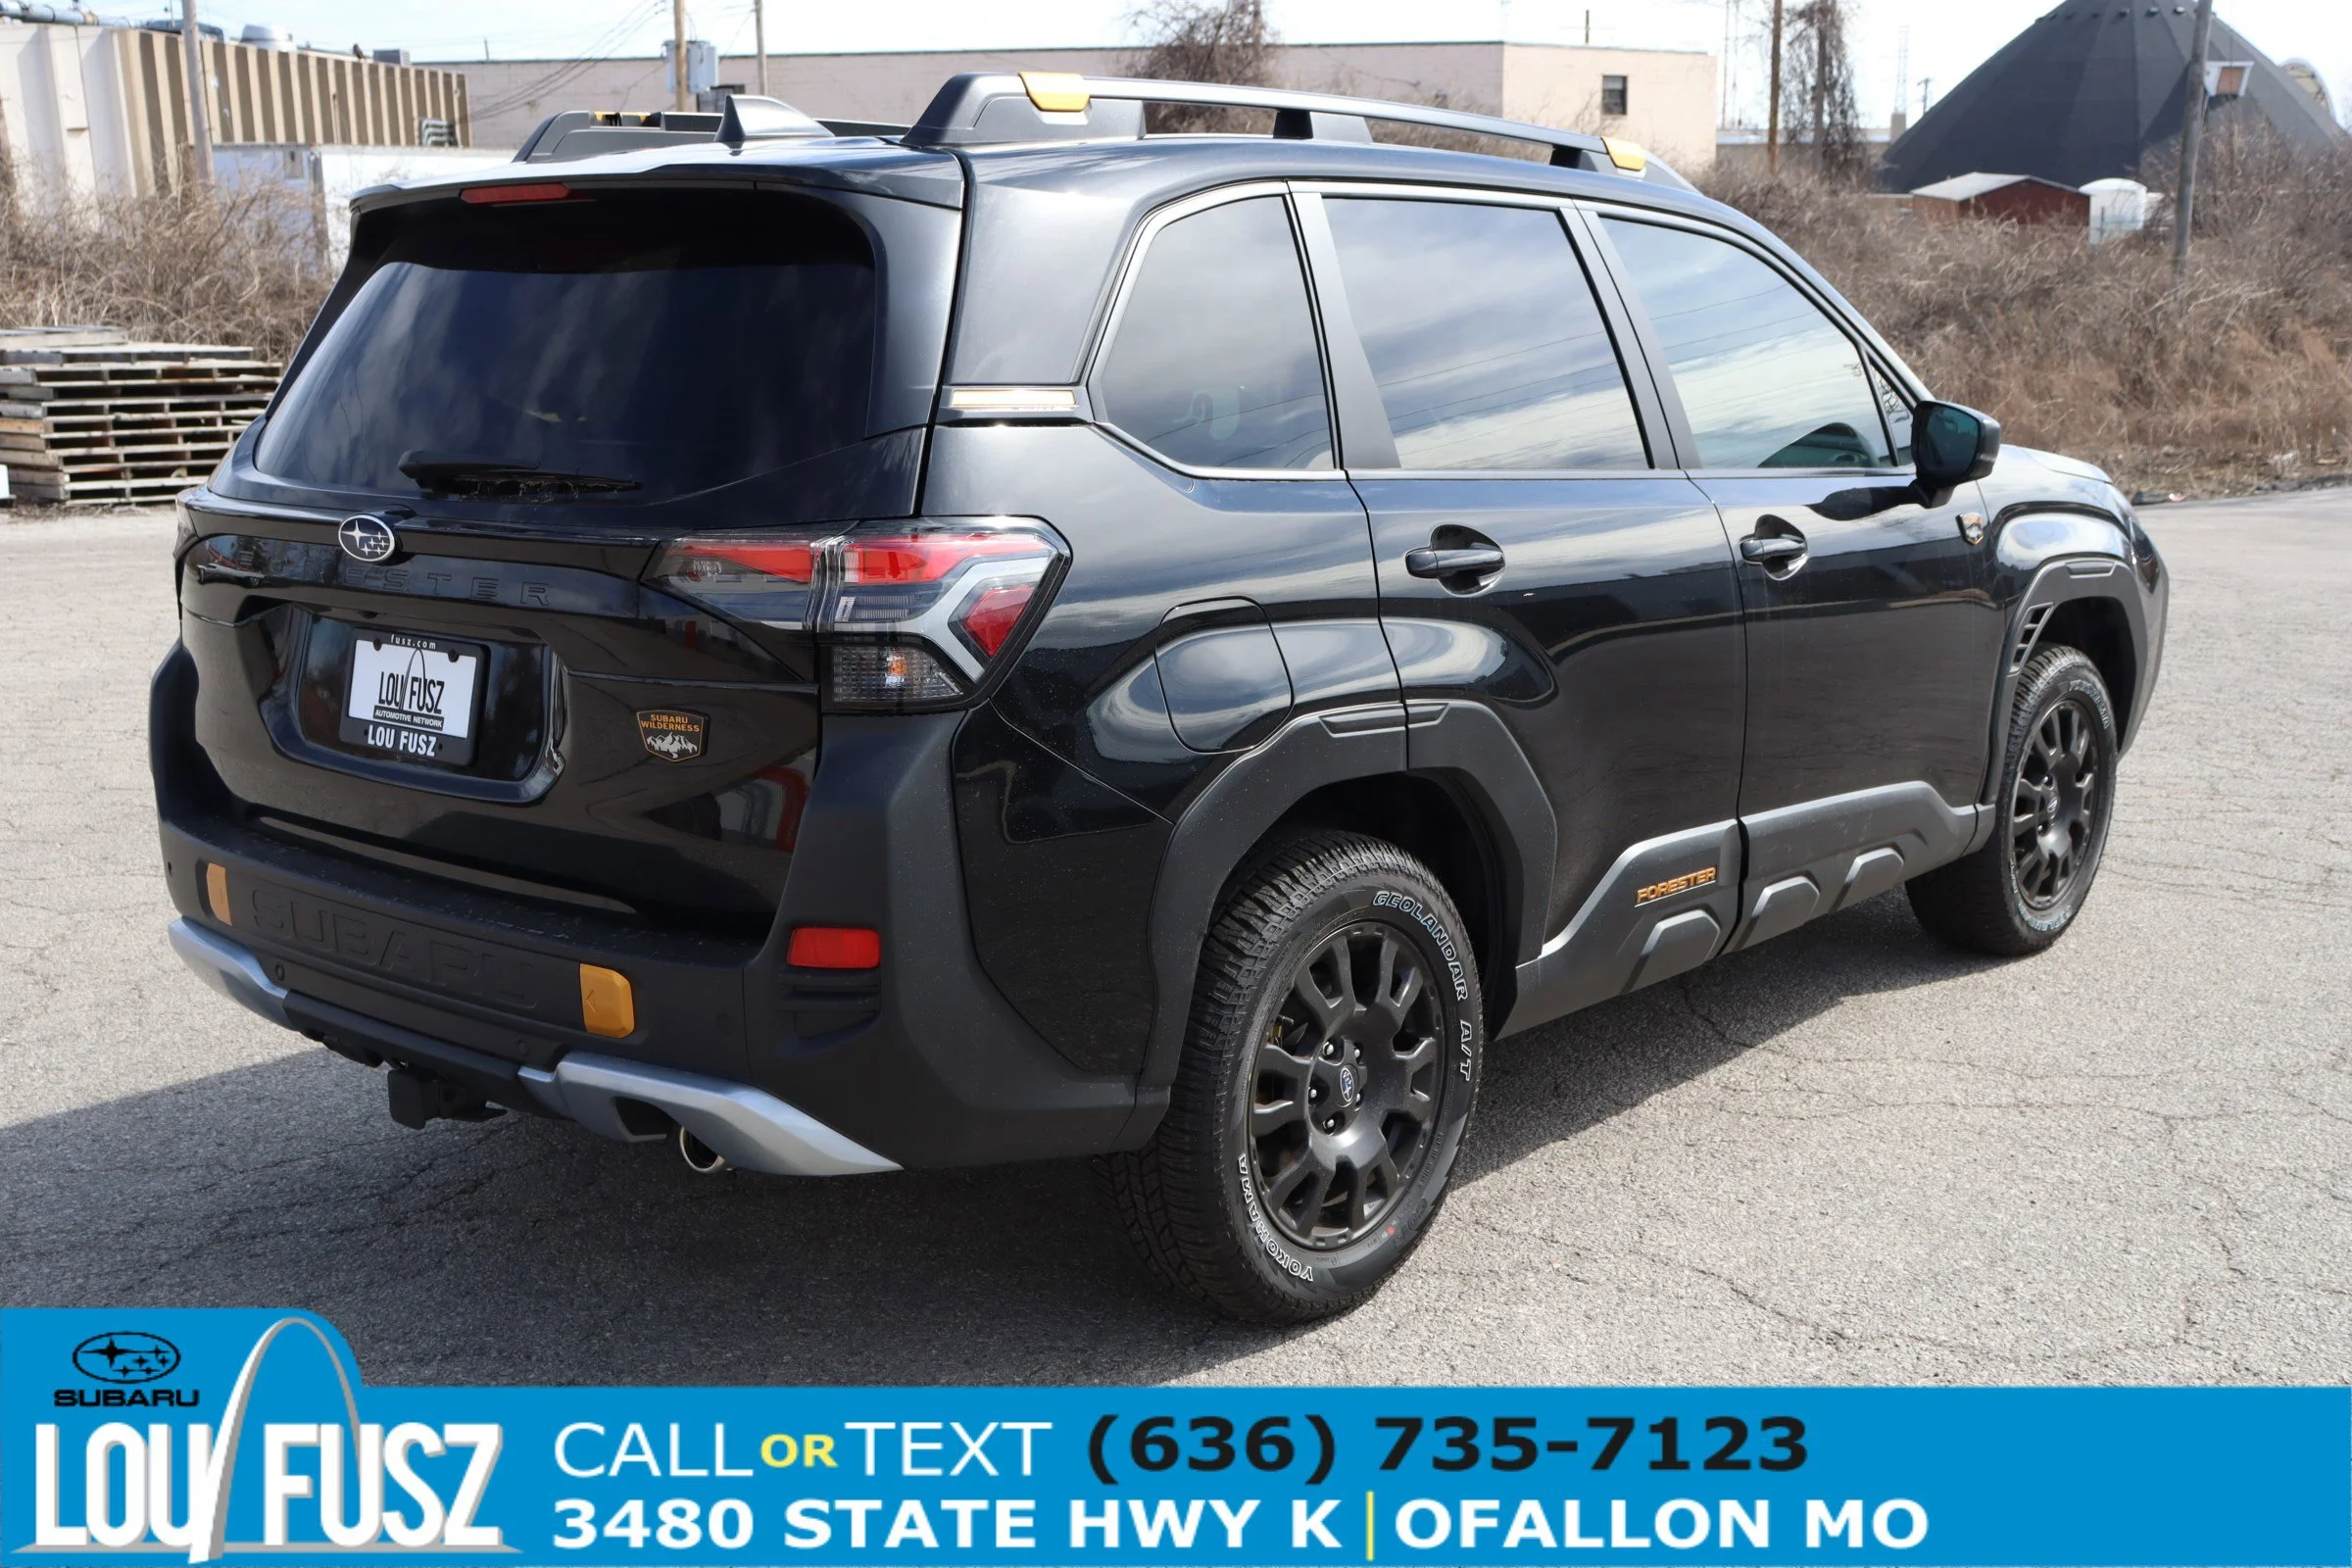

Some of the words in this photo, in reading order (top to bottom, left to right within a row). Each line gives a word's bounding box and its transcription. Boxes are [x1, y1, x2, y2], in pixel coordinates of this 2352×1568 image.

[390, 633, 437, 650] fusz.com
[378, 670, 405, 709] LOU
[409, 675, 445, 714] FUSZ
[374, 709, 412, 723] AUTOMOTIVE
[413, 715, 443, 728] NETWORK
[640, 720, 701, 732] WILDERNESS
[650, 713, 689, 724] SUBARU
[367, 724, 396, 750] LOU
[399, 731, 437, 758] FUSZ
[1637, 866, 1717, 905] FORESTER
[1372, 890, 1469, 1002] GEOLANDAR
[1459, 1019, 1473, 1082] A/T
[1238, 1152, 1314, 1282] YOKOHAMA
